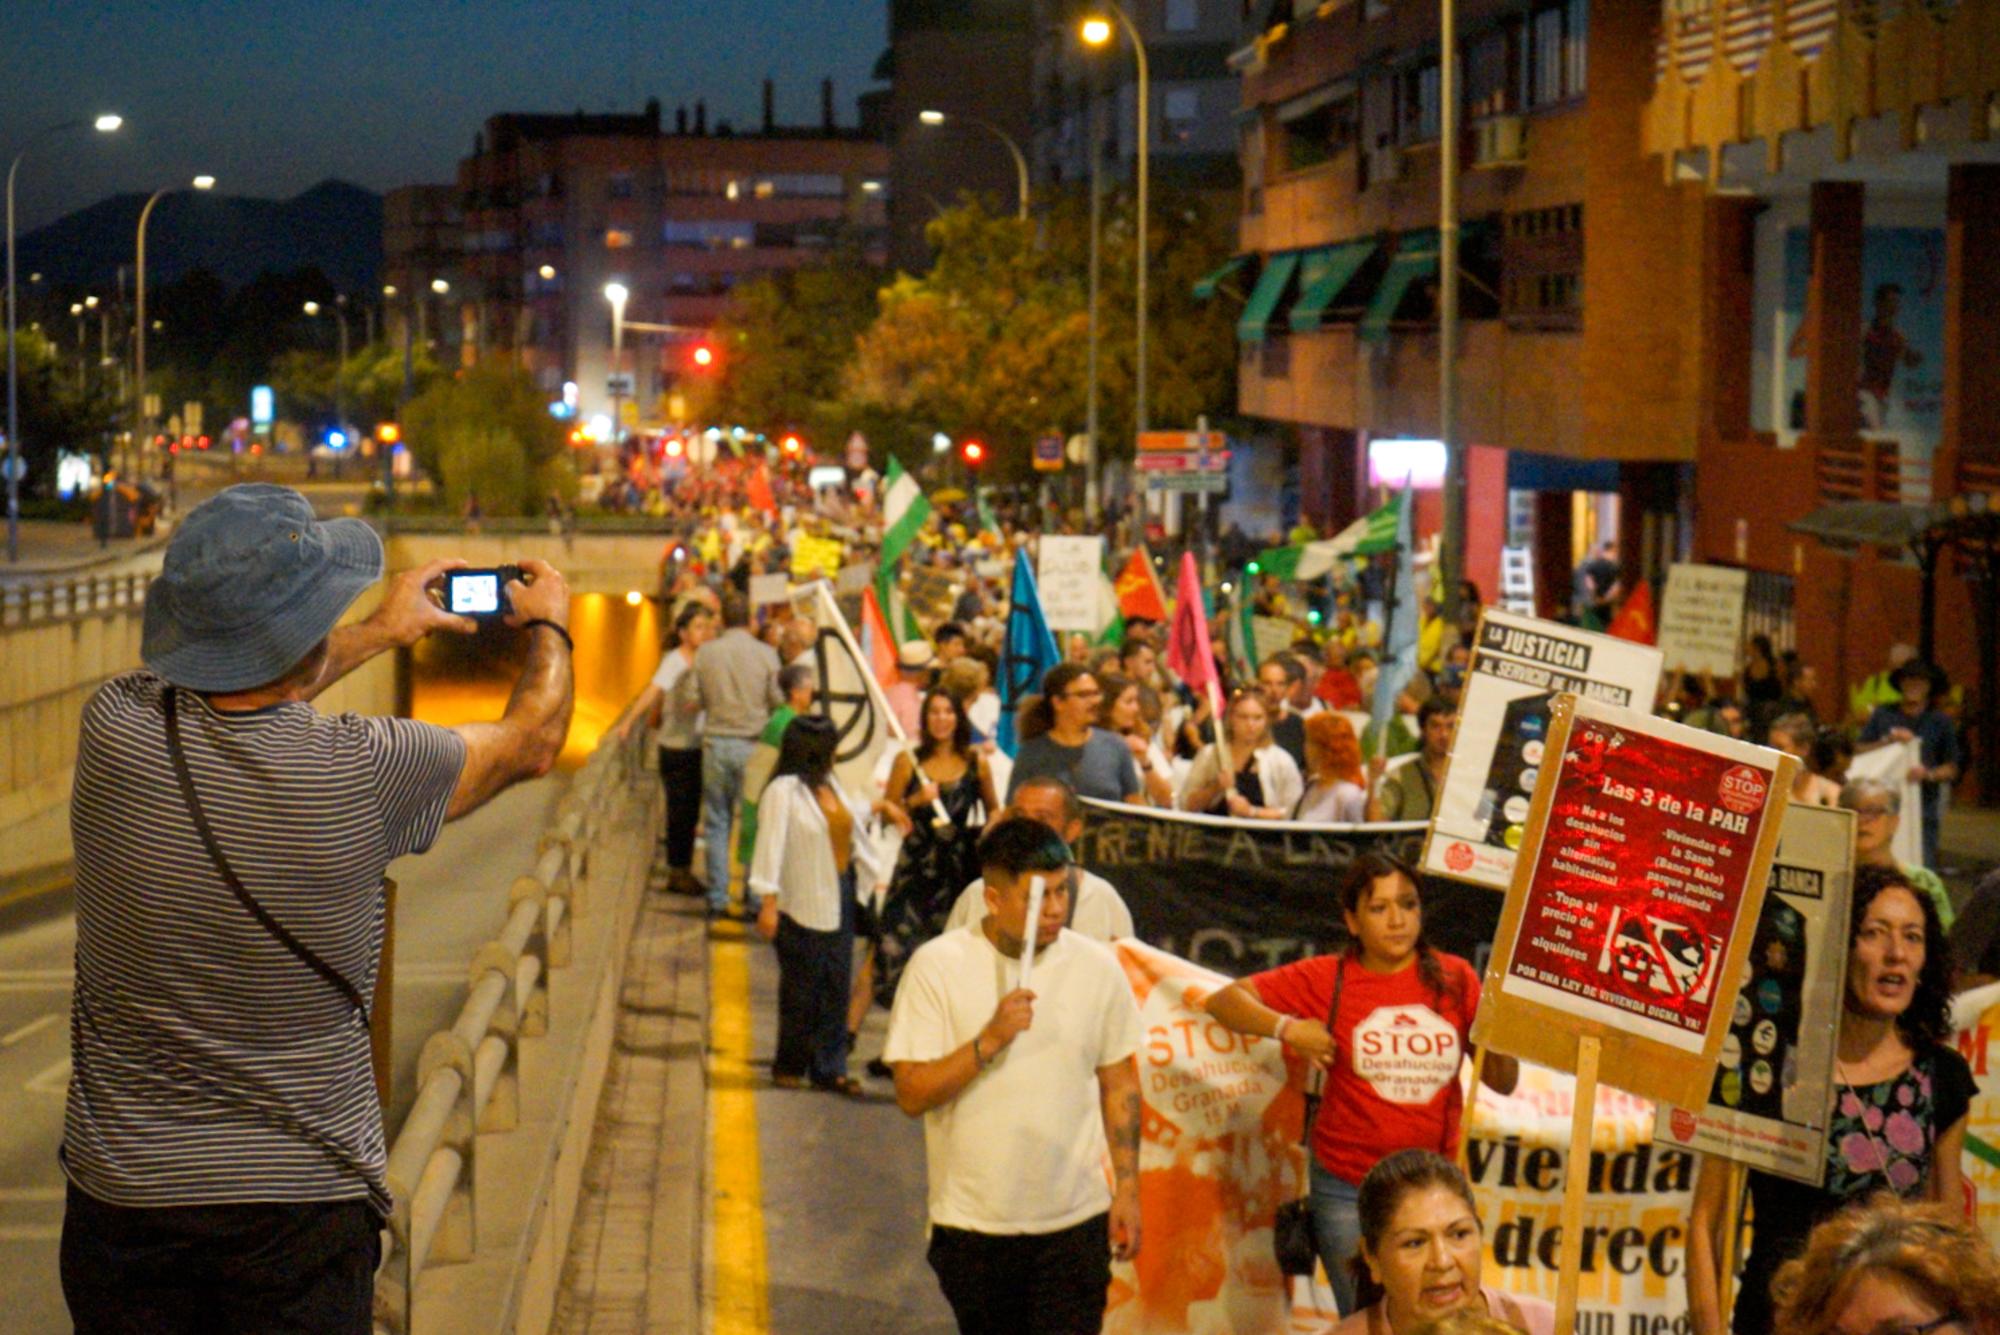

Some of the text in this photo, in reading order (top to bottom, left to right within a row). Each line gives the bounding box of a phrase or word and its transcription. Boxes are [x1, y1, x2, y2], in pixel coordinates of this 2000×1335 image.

[1488, 627, 1586, 672] LA JUSTICIA
[1498, 658, 1550, 687] SERVICIO
[1551, 674, 1568, 692] DE
[1584, 682, 1629, 708] BANCA
[1723, 775, 1765, 797] STOP
[1581, 804, 1597, 818] No
[1608, 812, 1625, 827] los
[1602, 776, 1637, 803] Las
[1640, 788, 1655, 806] 3
[1658, 793, 1683, 816] de
[1686, 799, 1704, 822] la
[1708, 807, 1750, 835] PAH
[1565, 816, 1626, 842] desahucios
[1583, 838, 1600, 850] sin
[1671, 845, 1715, 867] la Sareb
[1718, 845, 1732, 857] de
[1560, 846, 1617, 871] alternativa
[1551, 857, 1618, 887] habitacional
[1646, 871, 1684, 890] parque
[1780, 868, 1819, 895] BANCA
[1585, 901, 1599, 914] al
[1652, 887, 1712, 912] de vivienda
[1541, 906, 1595, 930] precio de
[1554, 925, 1573, 940] los
[1531, 937, 1588, 962] alquileres
[1516, 963, 1537, 978] POR
[1539, 970, 1560, 986] UNA
[1562, 977, 1583, 992] LEY
[1583, 984, 1598, 997] DE
[1600, 988, 1646, 1013] VIVIENDA
[1148, 1018, 1263, 1068] STOP
[1362, 1031, 1455, 1057] STOP
[1152, 1059, 1272, 1093] Desahucios
[1362, 1058, 1454, 1072] Desahucios
[1374, 1071, 1441, 1086] Granada
[1173, 1078, 1264, 1114] Granada
[1493, 1215, 1687, 1278] derec
